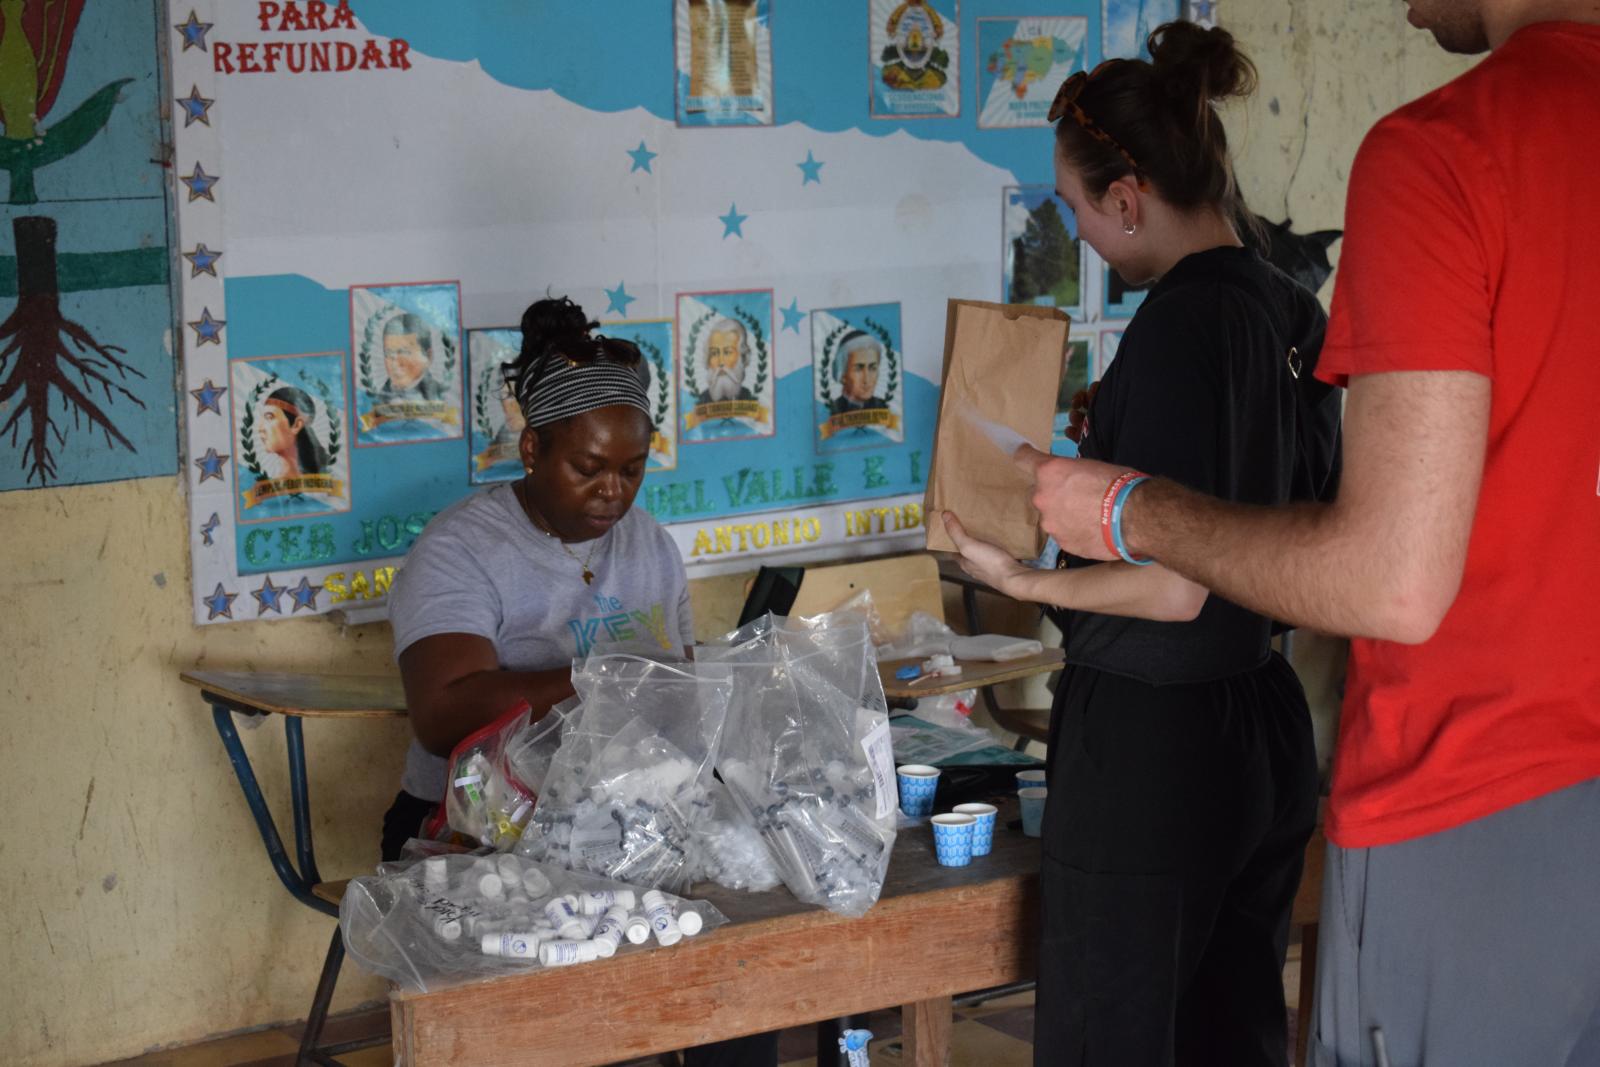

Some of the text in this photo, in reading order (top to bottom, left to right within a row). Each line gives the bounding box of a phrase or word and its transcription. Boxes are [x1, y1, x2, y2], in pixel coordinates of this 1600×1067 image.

[258, 0, 357, 32] PARA
[213, 37, 412, 75] REFUNDAR
[244, 521, 337, 567] CEB
[353, 511, 438, 555] JOS
[721, 461, 839, 508] VALLE
[690, 515, 823, 557] ANTONIO
[843, 502, 928, 538] INTIB
[567, 603, 673, 658] KEY
